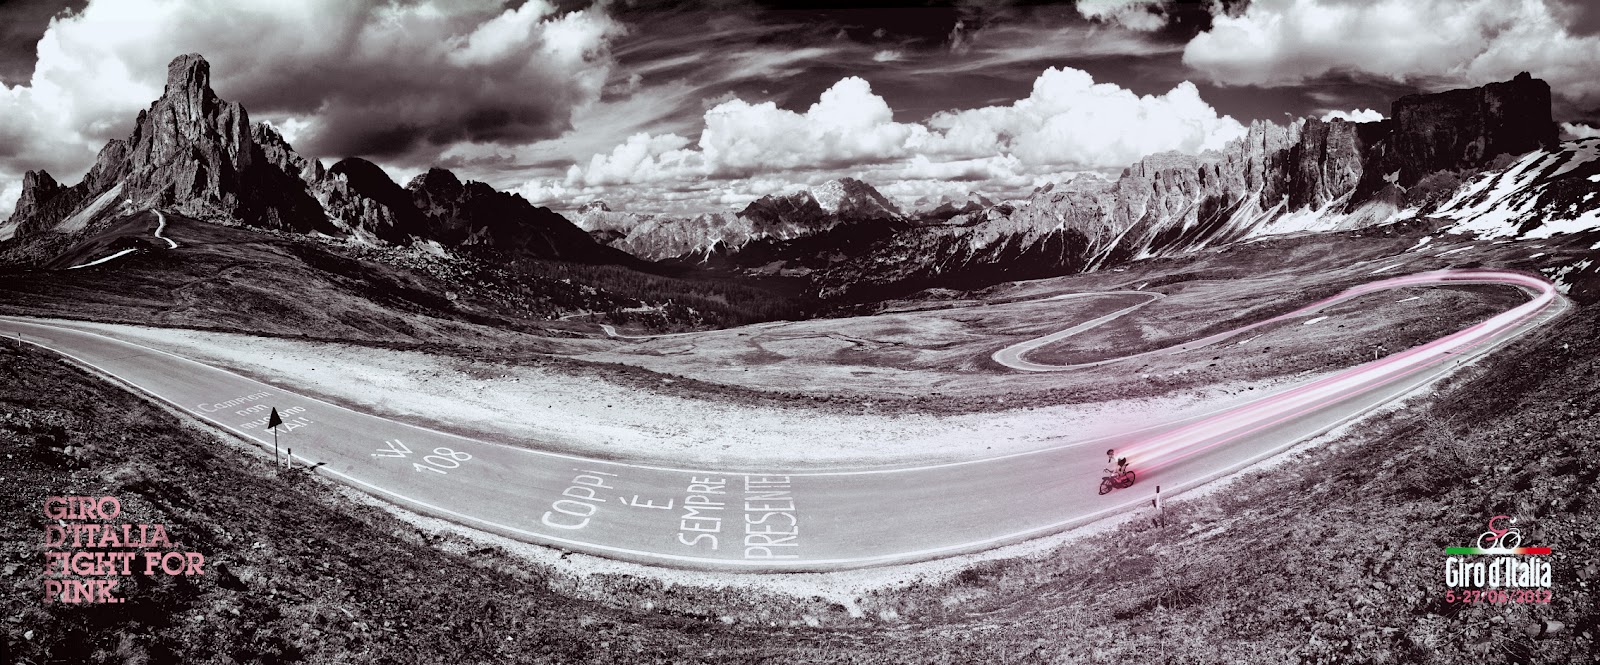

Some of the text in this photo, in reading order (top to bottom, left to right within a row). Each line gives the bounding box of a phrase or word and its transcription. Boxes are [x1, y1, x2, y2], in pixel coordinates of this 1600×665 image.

[197, 389, 274, 413] Campioni
[235, 403, 269, 417] non
[239, 405, 306, 430] muoono
[412, 446, 473, 475] 108
[678, 476, 726, 551] SEMPRE
[744, 475, 799, 560] PRESENTE
